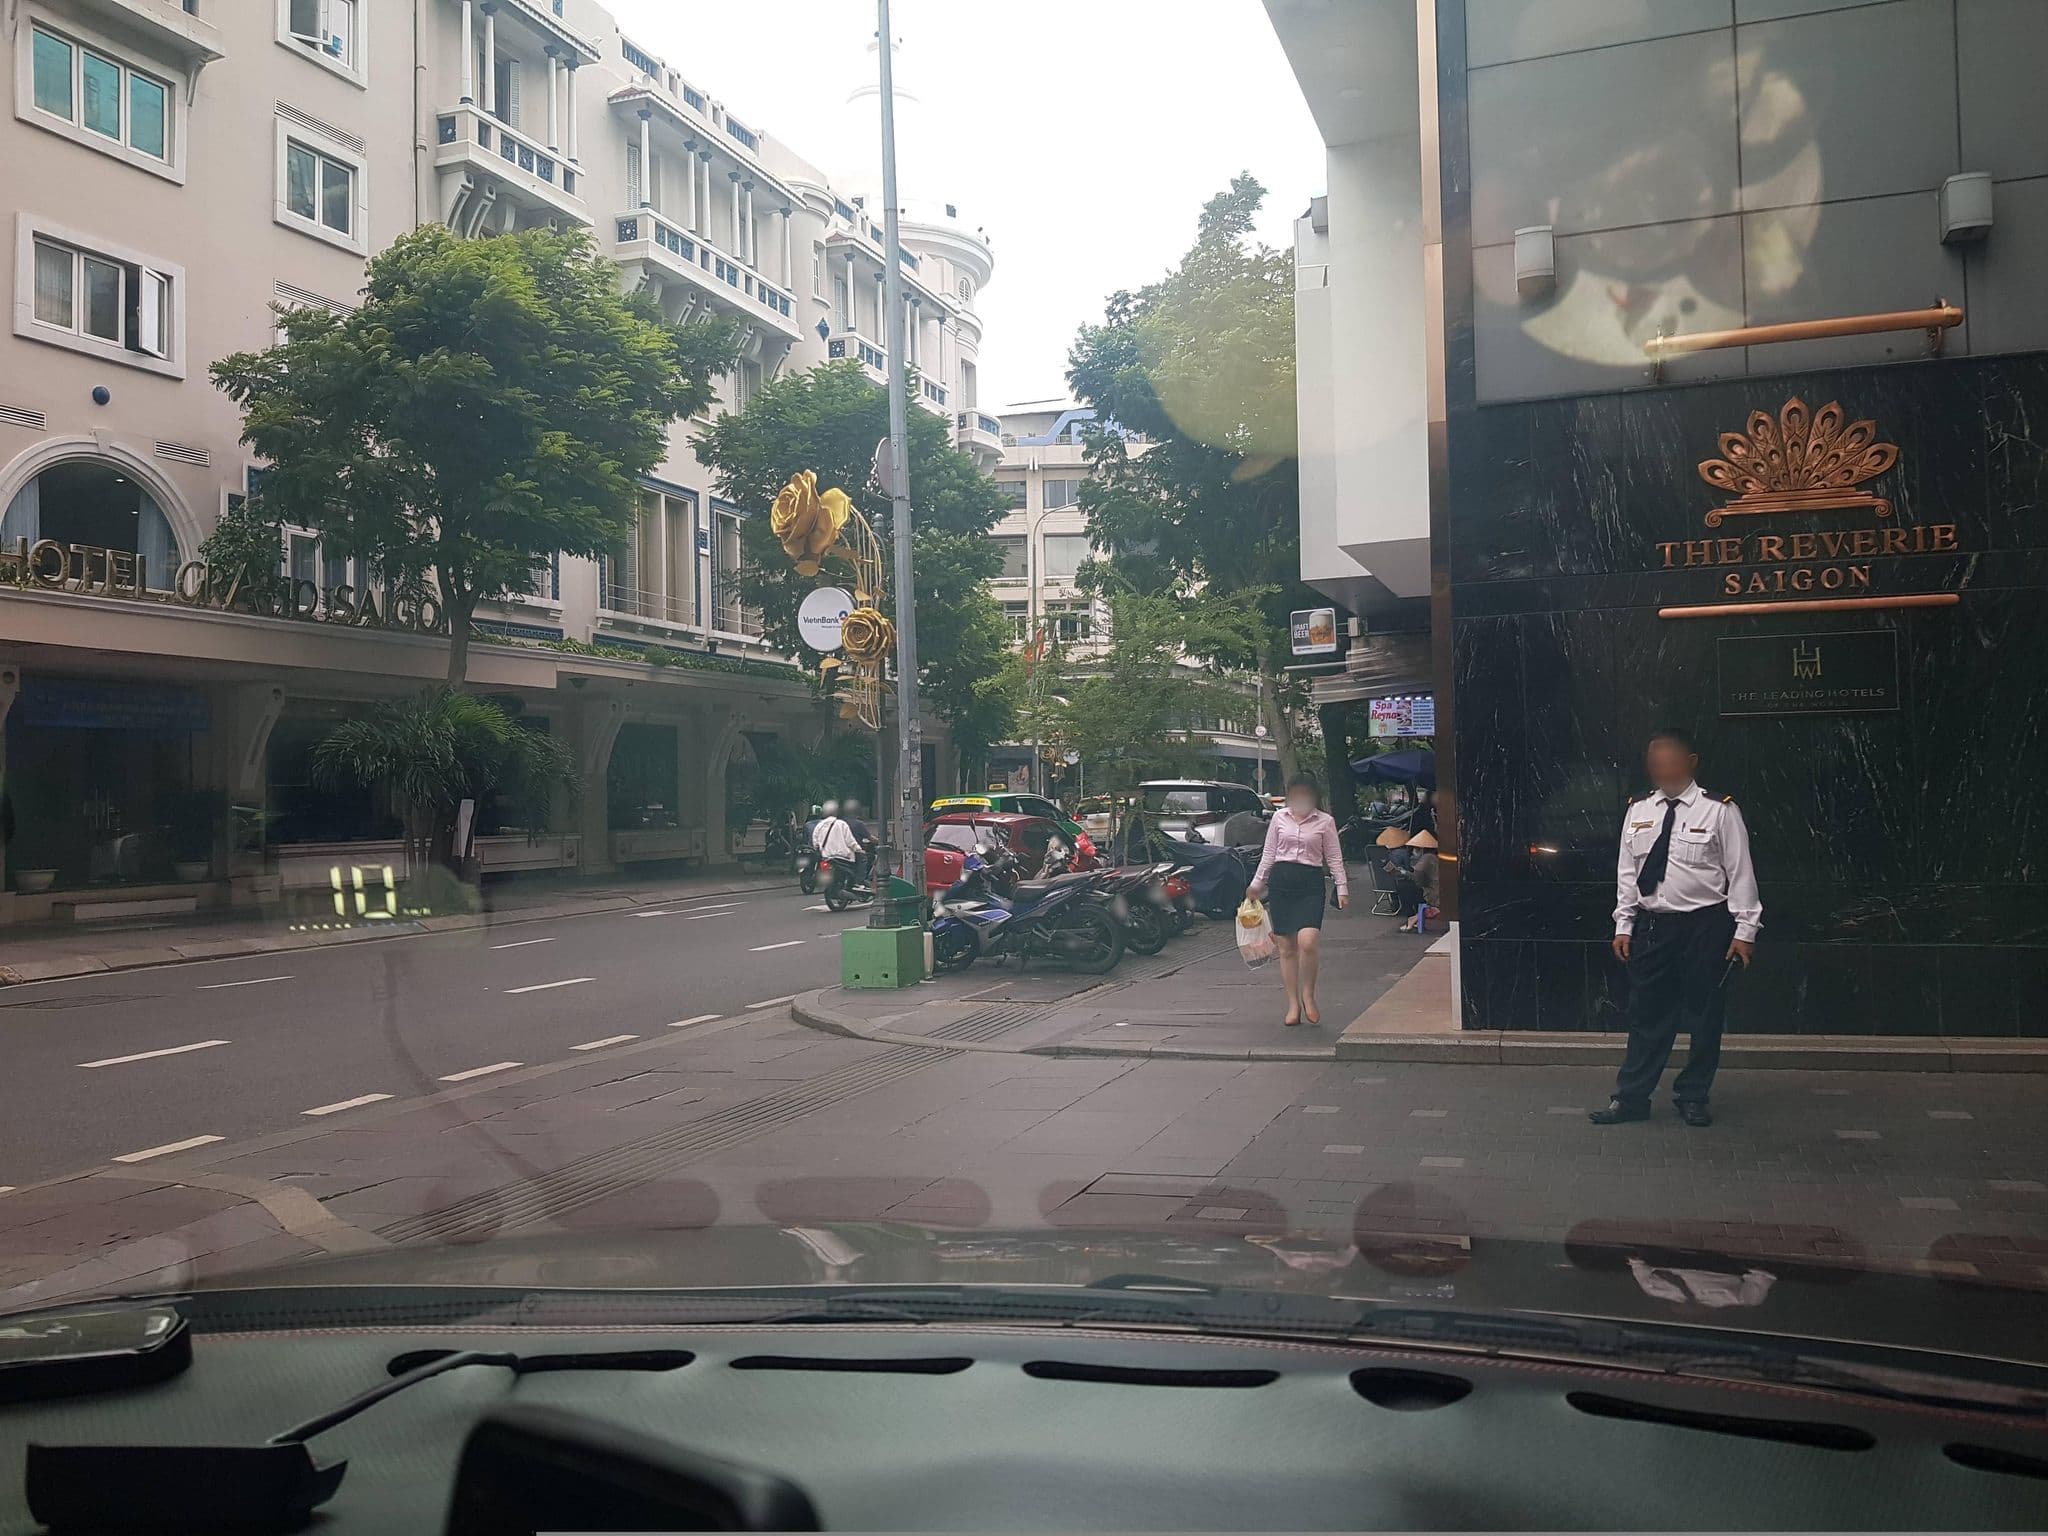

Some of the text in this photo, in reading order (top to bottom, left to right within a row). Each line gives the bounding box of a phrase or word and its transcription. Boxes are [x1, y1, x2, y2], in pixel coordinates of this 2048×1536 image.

[1656, 524, 1959, 568] THE REVERIE
[0, 535, 161, 601] HOTEL
[334, 584, 453, 635] SAIGO
[1724, 565, 1873, 596] SAIGON
[1375, 701, 1392, 711] Spa
[1763, 689, 1825, 701] LEADING
[1827, 687, 1885, 698] HOTELS
[1371, 709, 1398, 721] Reyna
[330, 865, 397, 919] 10
